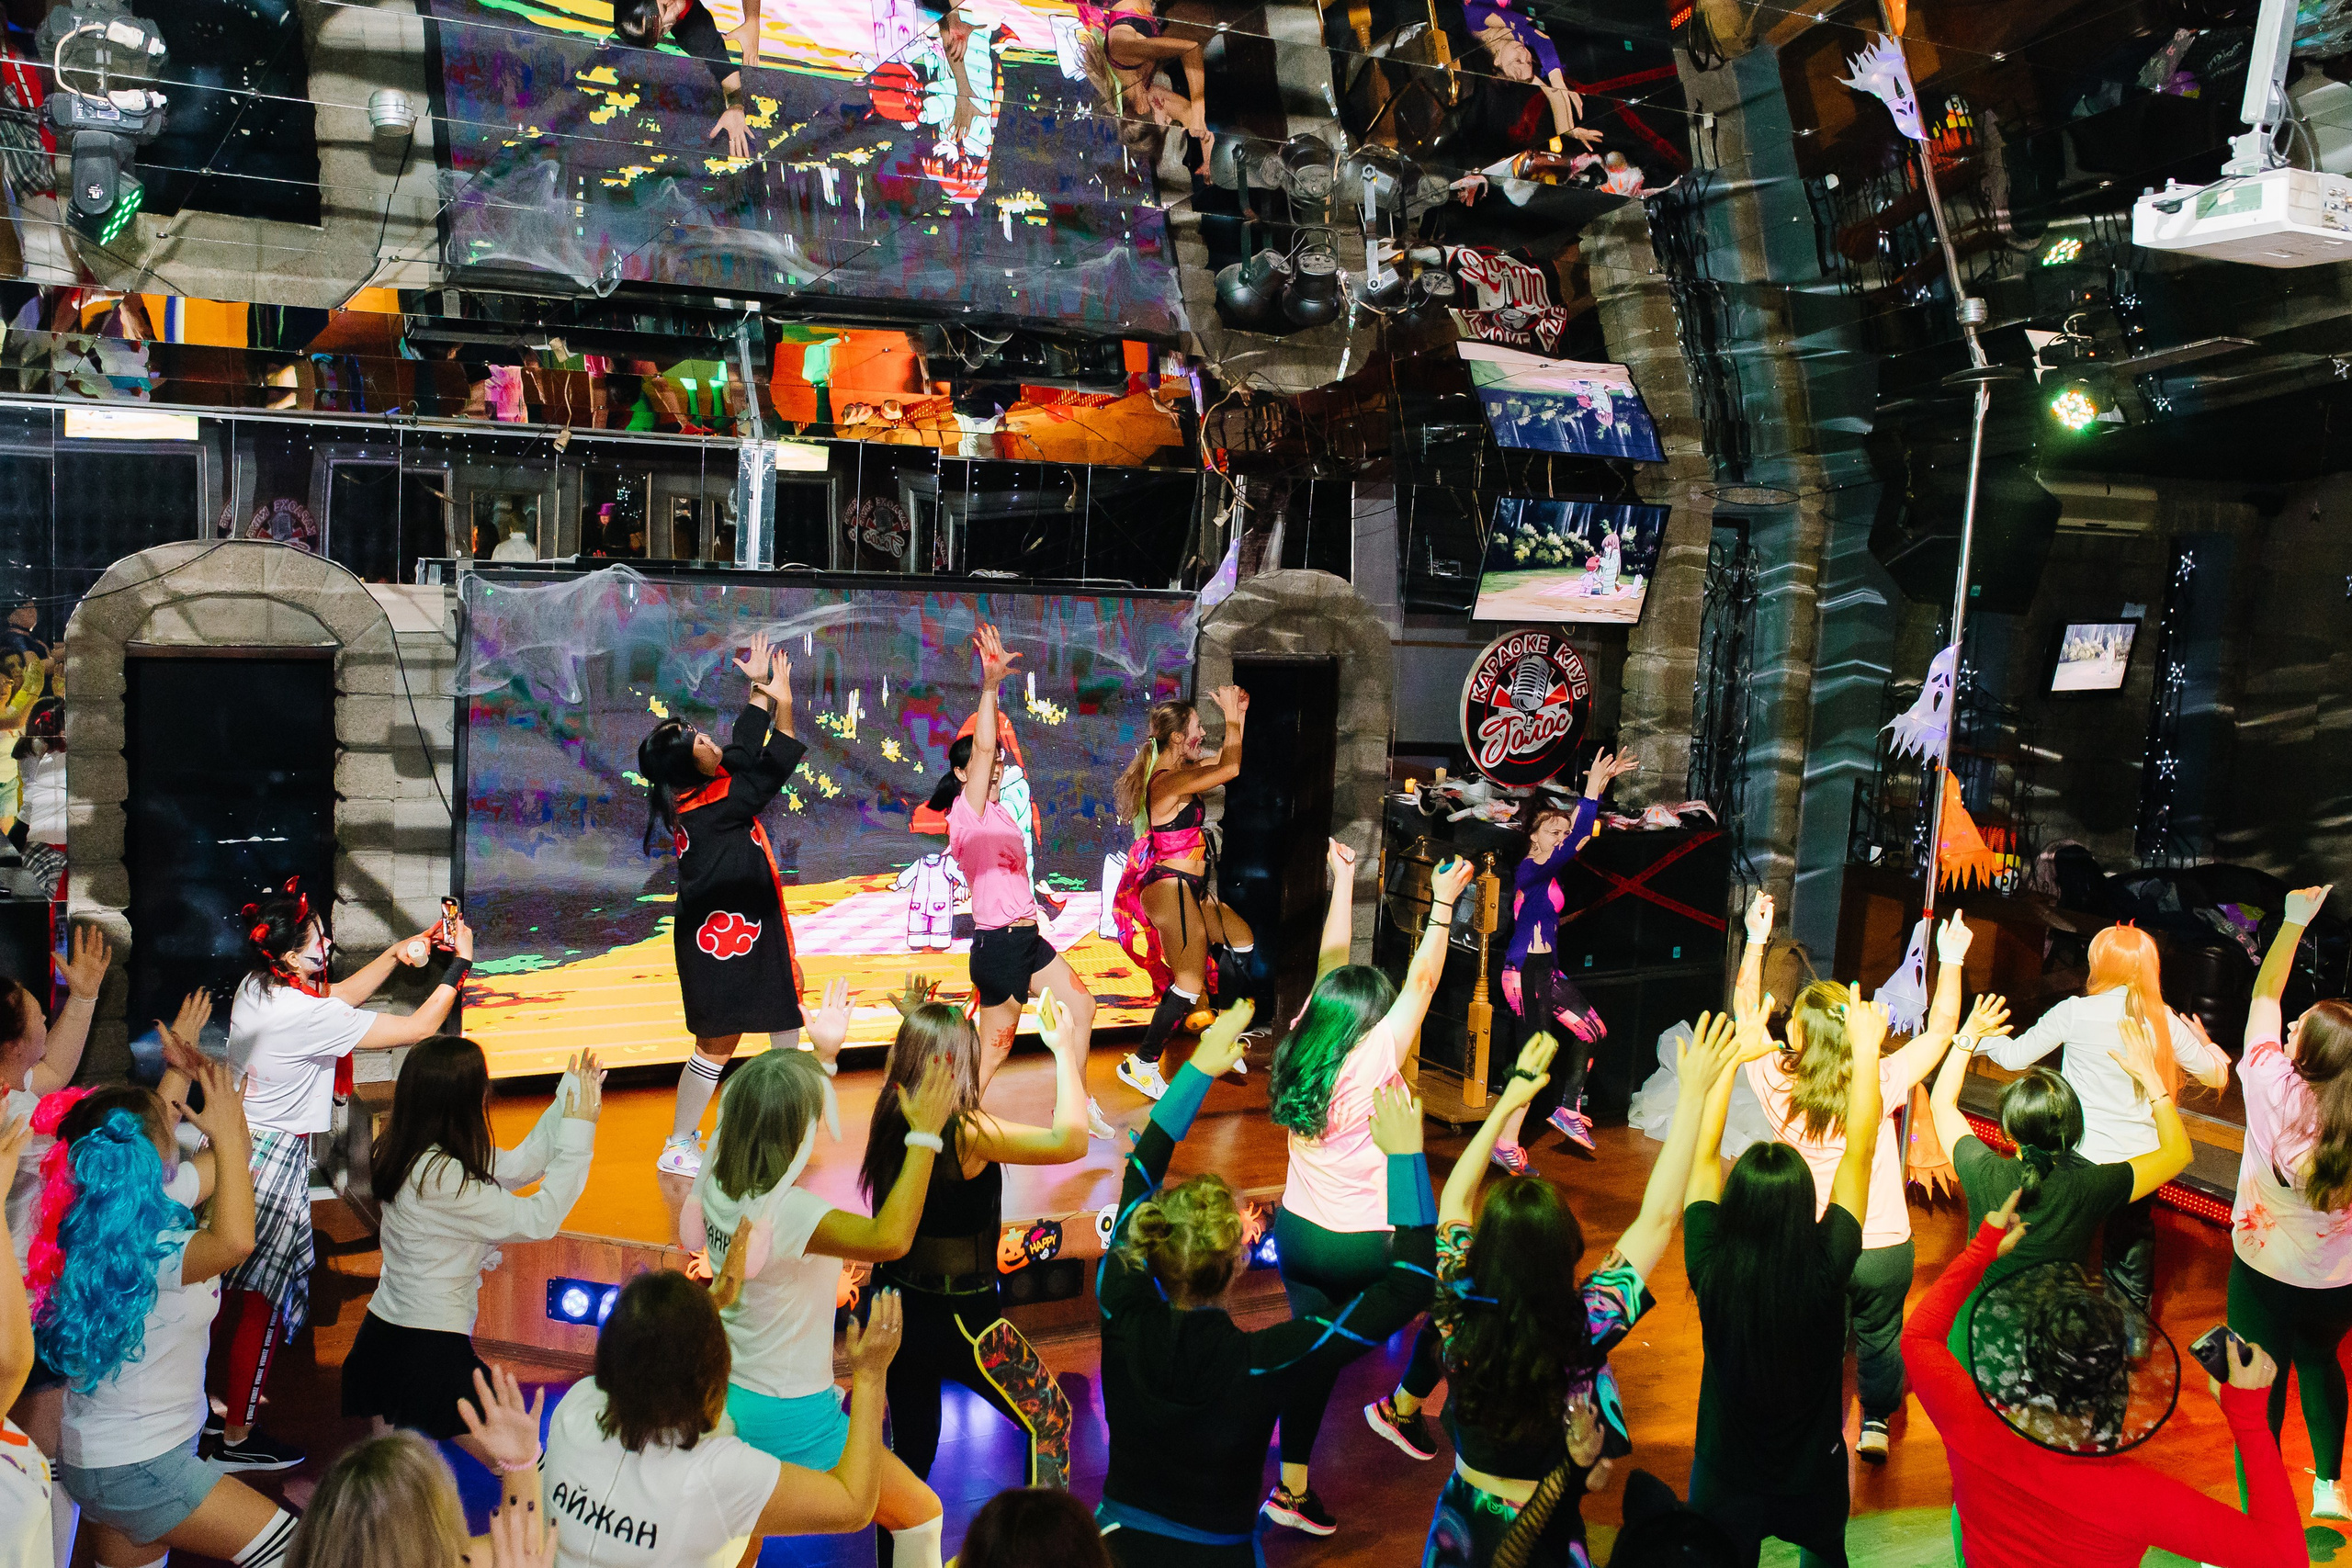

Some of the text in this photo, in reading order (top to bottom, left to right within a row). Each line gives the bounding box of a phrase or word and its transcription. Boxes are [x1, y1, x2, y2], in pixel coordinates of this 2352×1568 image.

[1471, 634, 1589, 703] КАРАОКЕ КЛУБ
[1478, 708, 1573, 768] Голос
[1029, 1235, 1057, 1255] HAPPY
[553, 1482, 658, 1550] АЙЖАН
